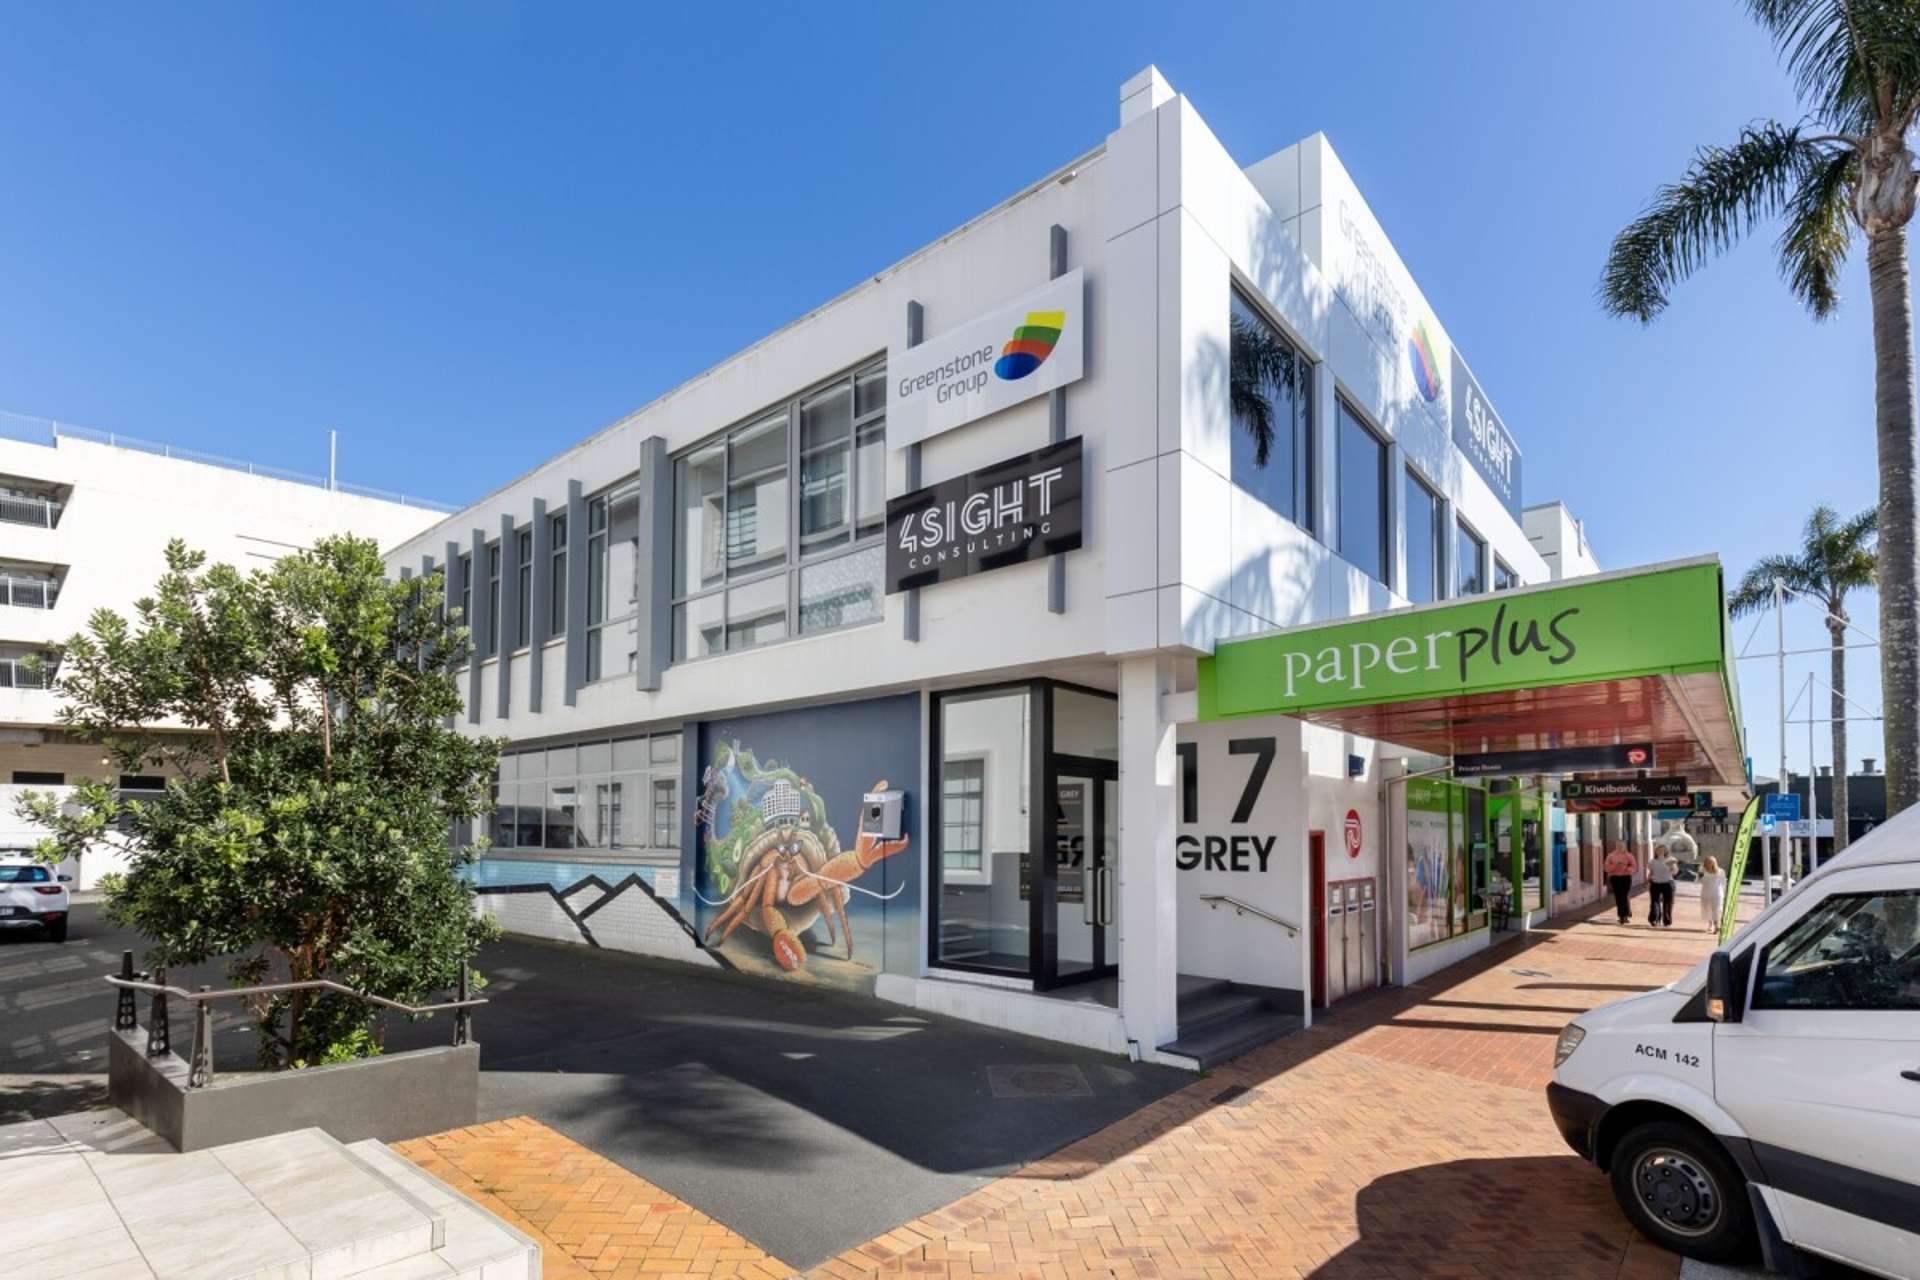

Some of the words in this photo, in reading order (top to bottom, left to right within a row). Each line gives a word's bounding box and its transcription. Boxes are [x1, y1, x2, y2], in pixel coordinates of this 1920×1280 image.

[899, 345, 993, 398] Greenstone
[936, 369, 989, 405] Group
[1465, 384, 1513, 484] 4SIGHT
[899, 468, 1063, 553] 4SIGHT
[909, 523, 1052, 570] CONSULTING
[1060, 790, 1079, 799] GREY
[1176, 737, 1277, 824] 17
[1660, 785, 1681, 793] ATM
[1176, 835, 1277, 873] GREY
[1635, 1043, 1667, 1060] ACM
[1674, 1052, 1700, 1068] 142
